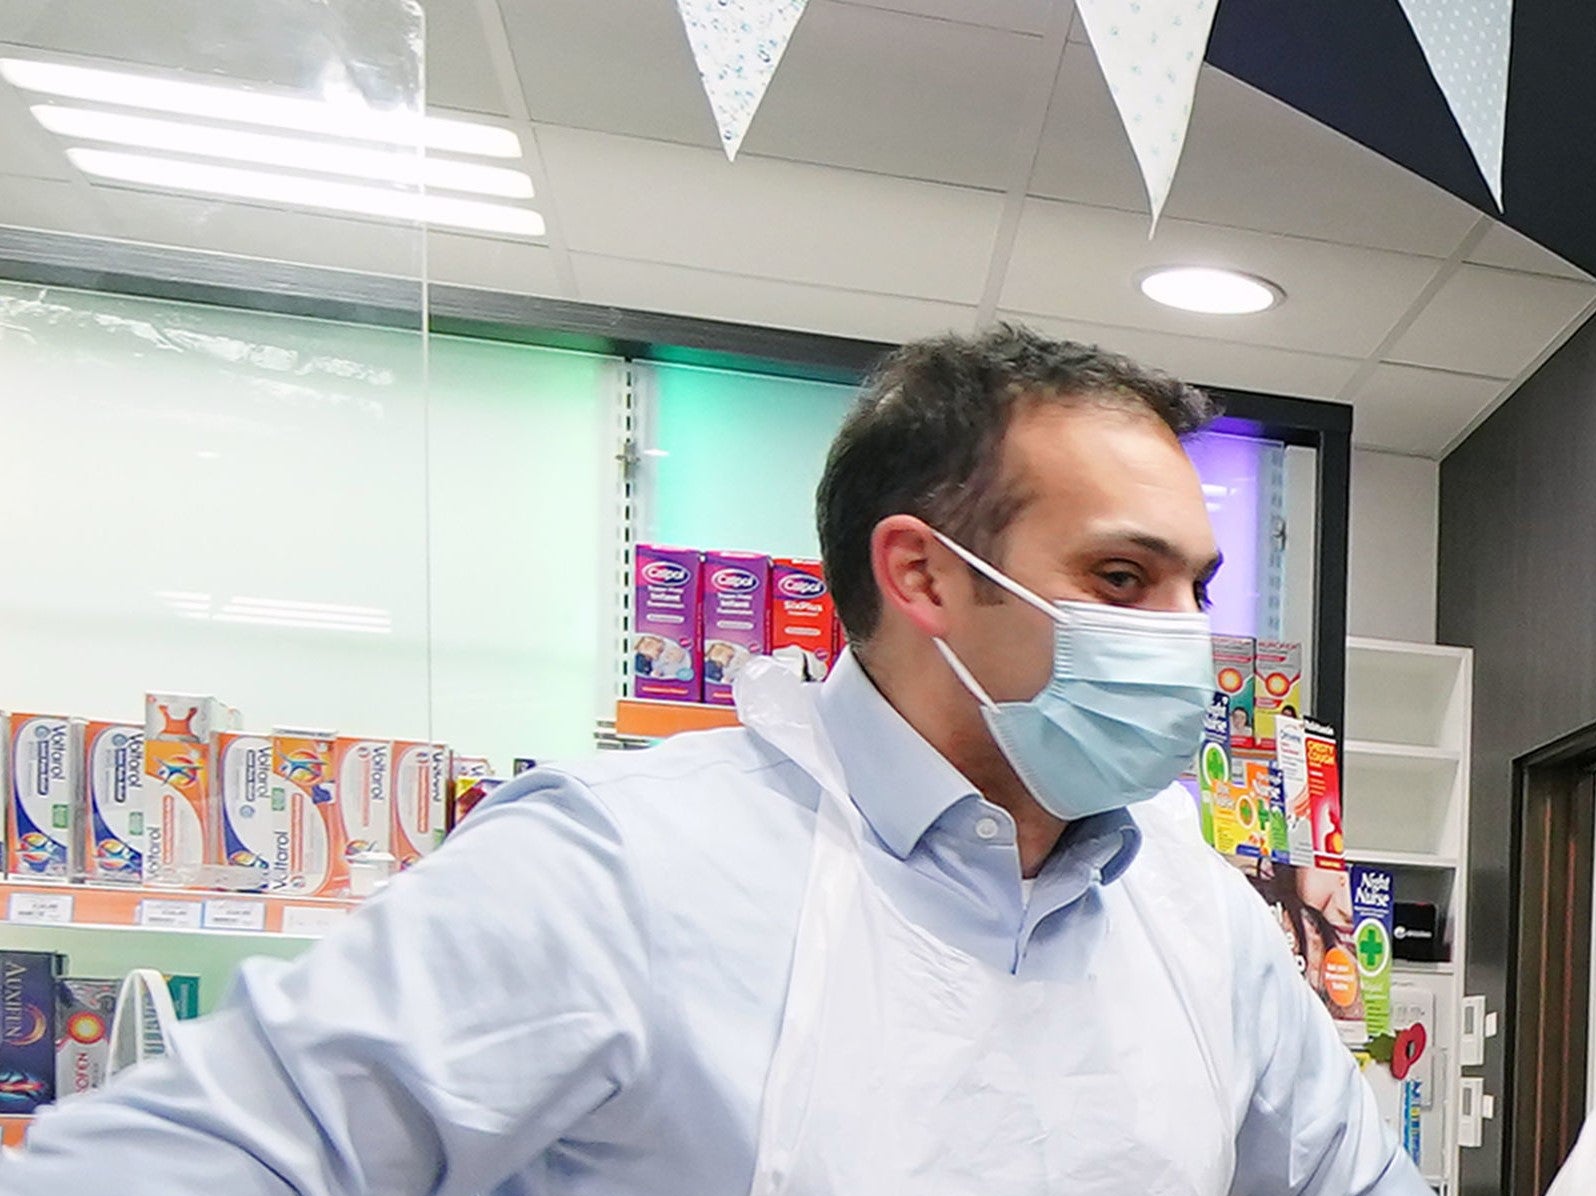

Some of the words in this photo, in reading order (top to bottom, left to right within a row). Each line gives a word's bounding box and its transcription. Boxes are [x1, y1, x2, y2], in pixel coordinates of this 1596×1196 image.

[51, 725, 67, 780] Voltarol
[127, 733, 143, 787] Voltarol
[257, 746, 272, 799] Voltarol
[371, 745, 387, 801] Voltarol
[1354, 887, 1390, 908] Nurse
[1362, 872, 1390, 894] Night
